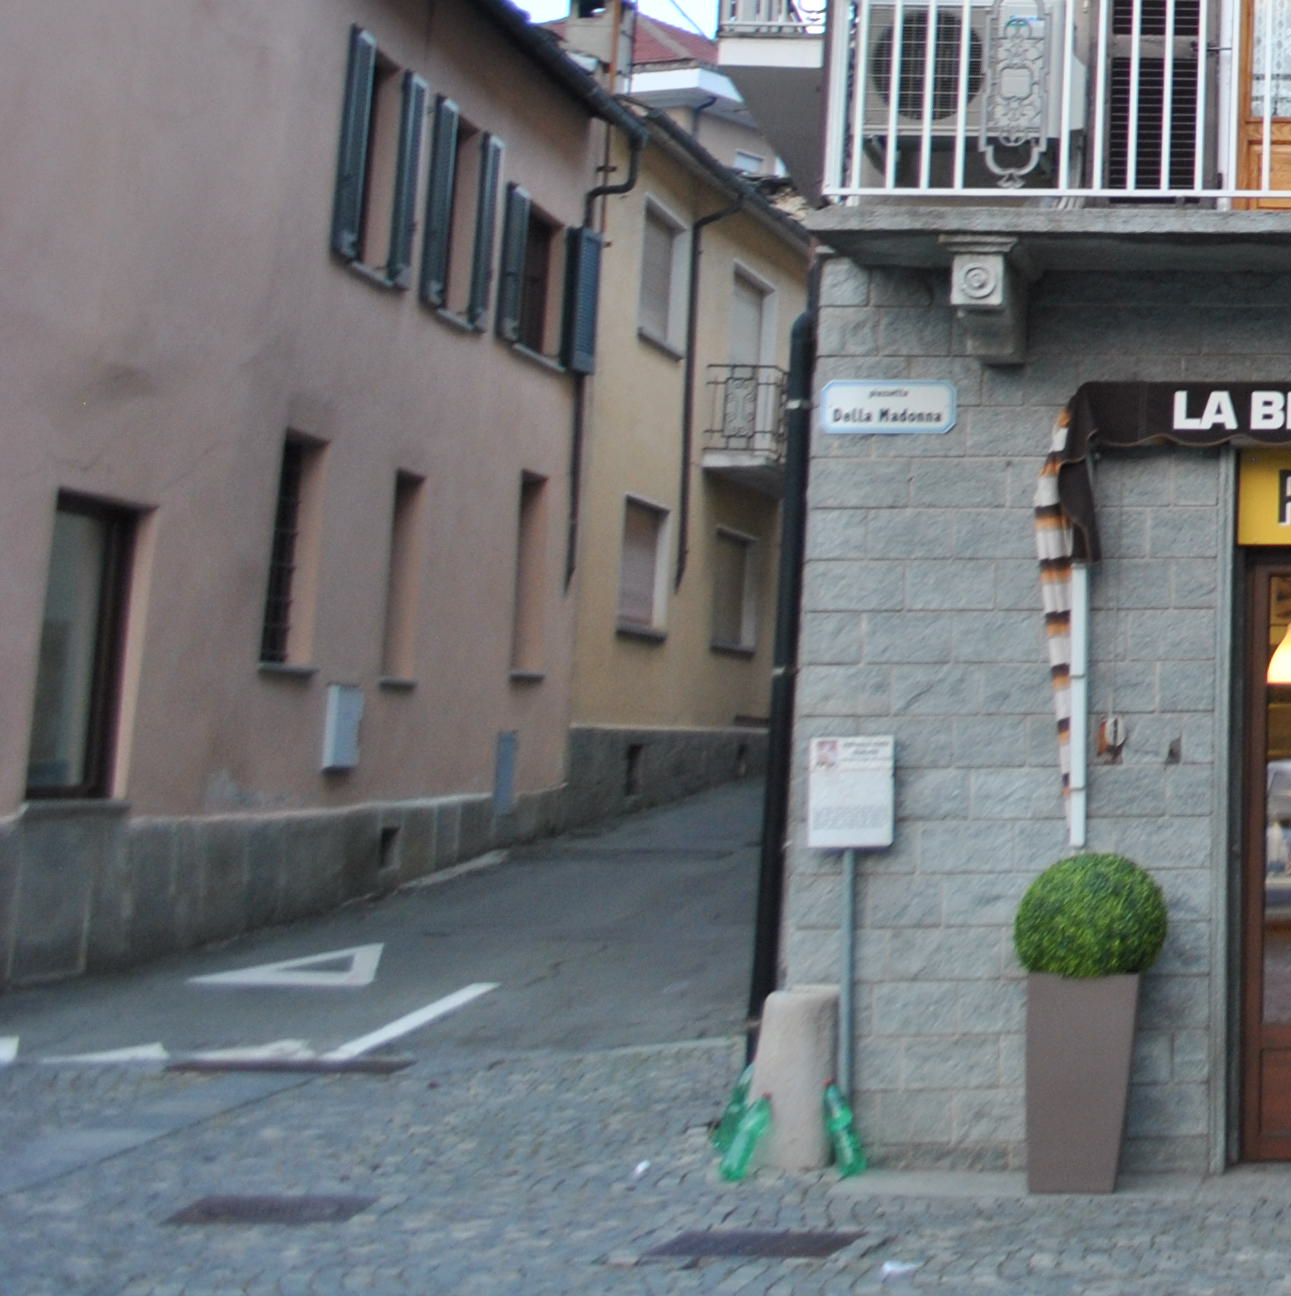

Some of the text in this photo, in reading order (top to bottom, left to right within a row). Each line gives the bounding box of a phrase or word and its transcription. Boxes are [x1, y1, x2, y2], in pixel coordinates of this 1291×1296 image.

[832, 408, 942, 423] Della Madonna
[1172, 390, 1239, 431] LA
